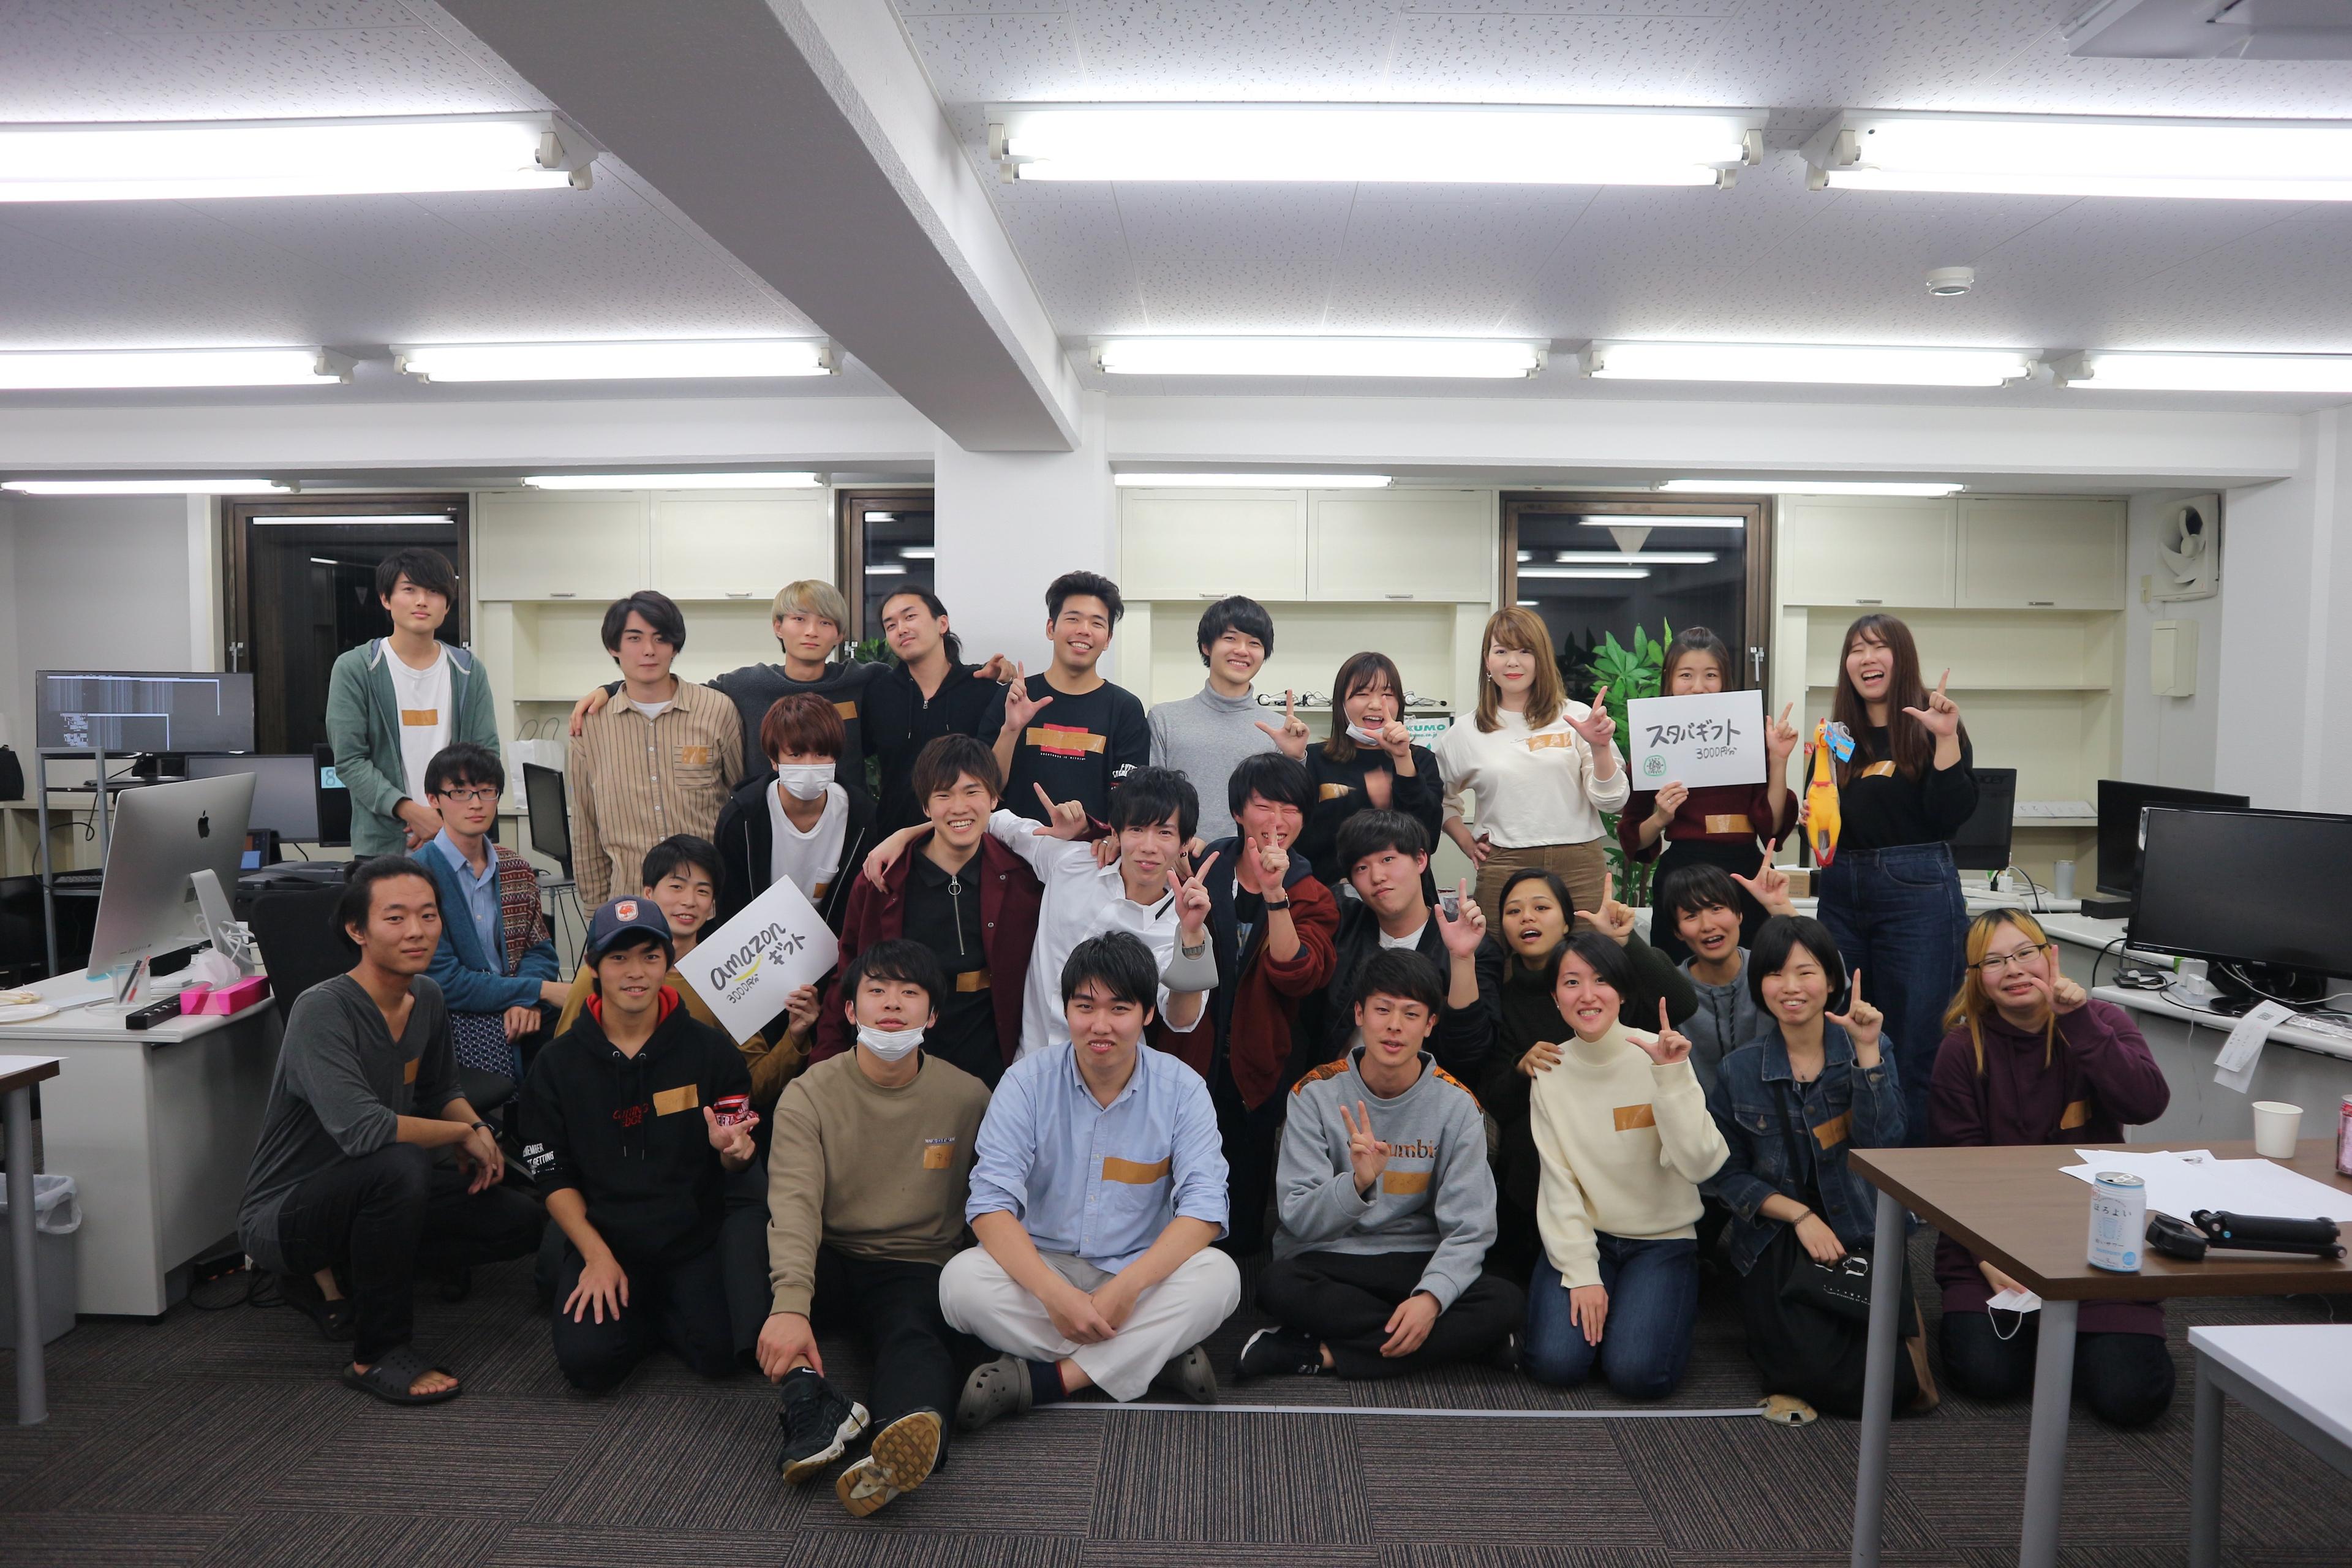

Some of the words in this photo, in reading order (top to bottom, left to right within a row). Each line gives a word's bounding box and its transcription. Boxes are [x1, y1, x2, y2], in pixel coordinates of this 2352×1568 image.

[1646, 718, 1741, 748] スタバギフト
[1696, 745, 1738, 760] 3000円分
[325, 769, 336, 786] 8
[710, 922, 786, 990] amazon
[768, 933, 805, 965] ギフト
[726, 974, 760, 1004] 3000円分
[2094, 1203, 2132, 1217] ほろよい
